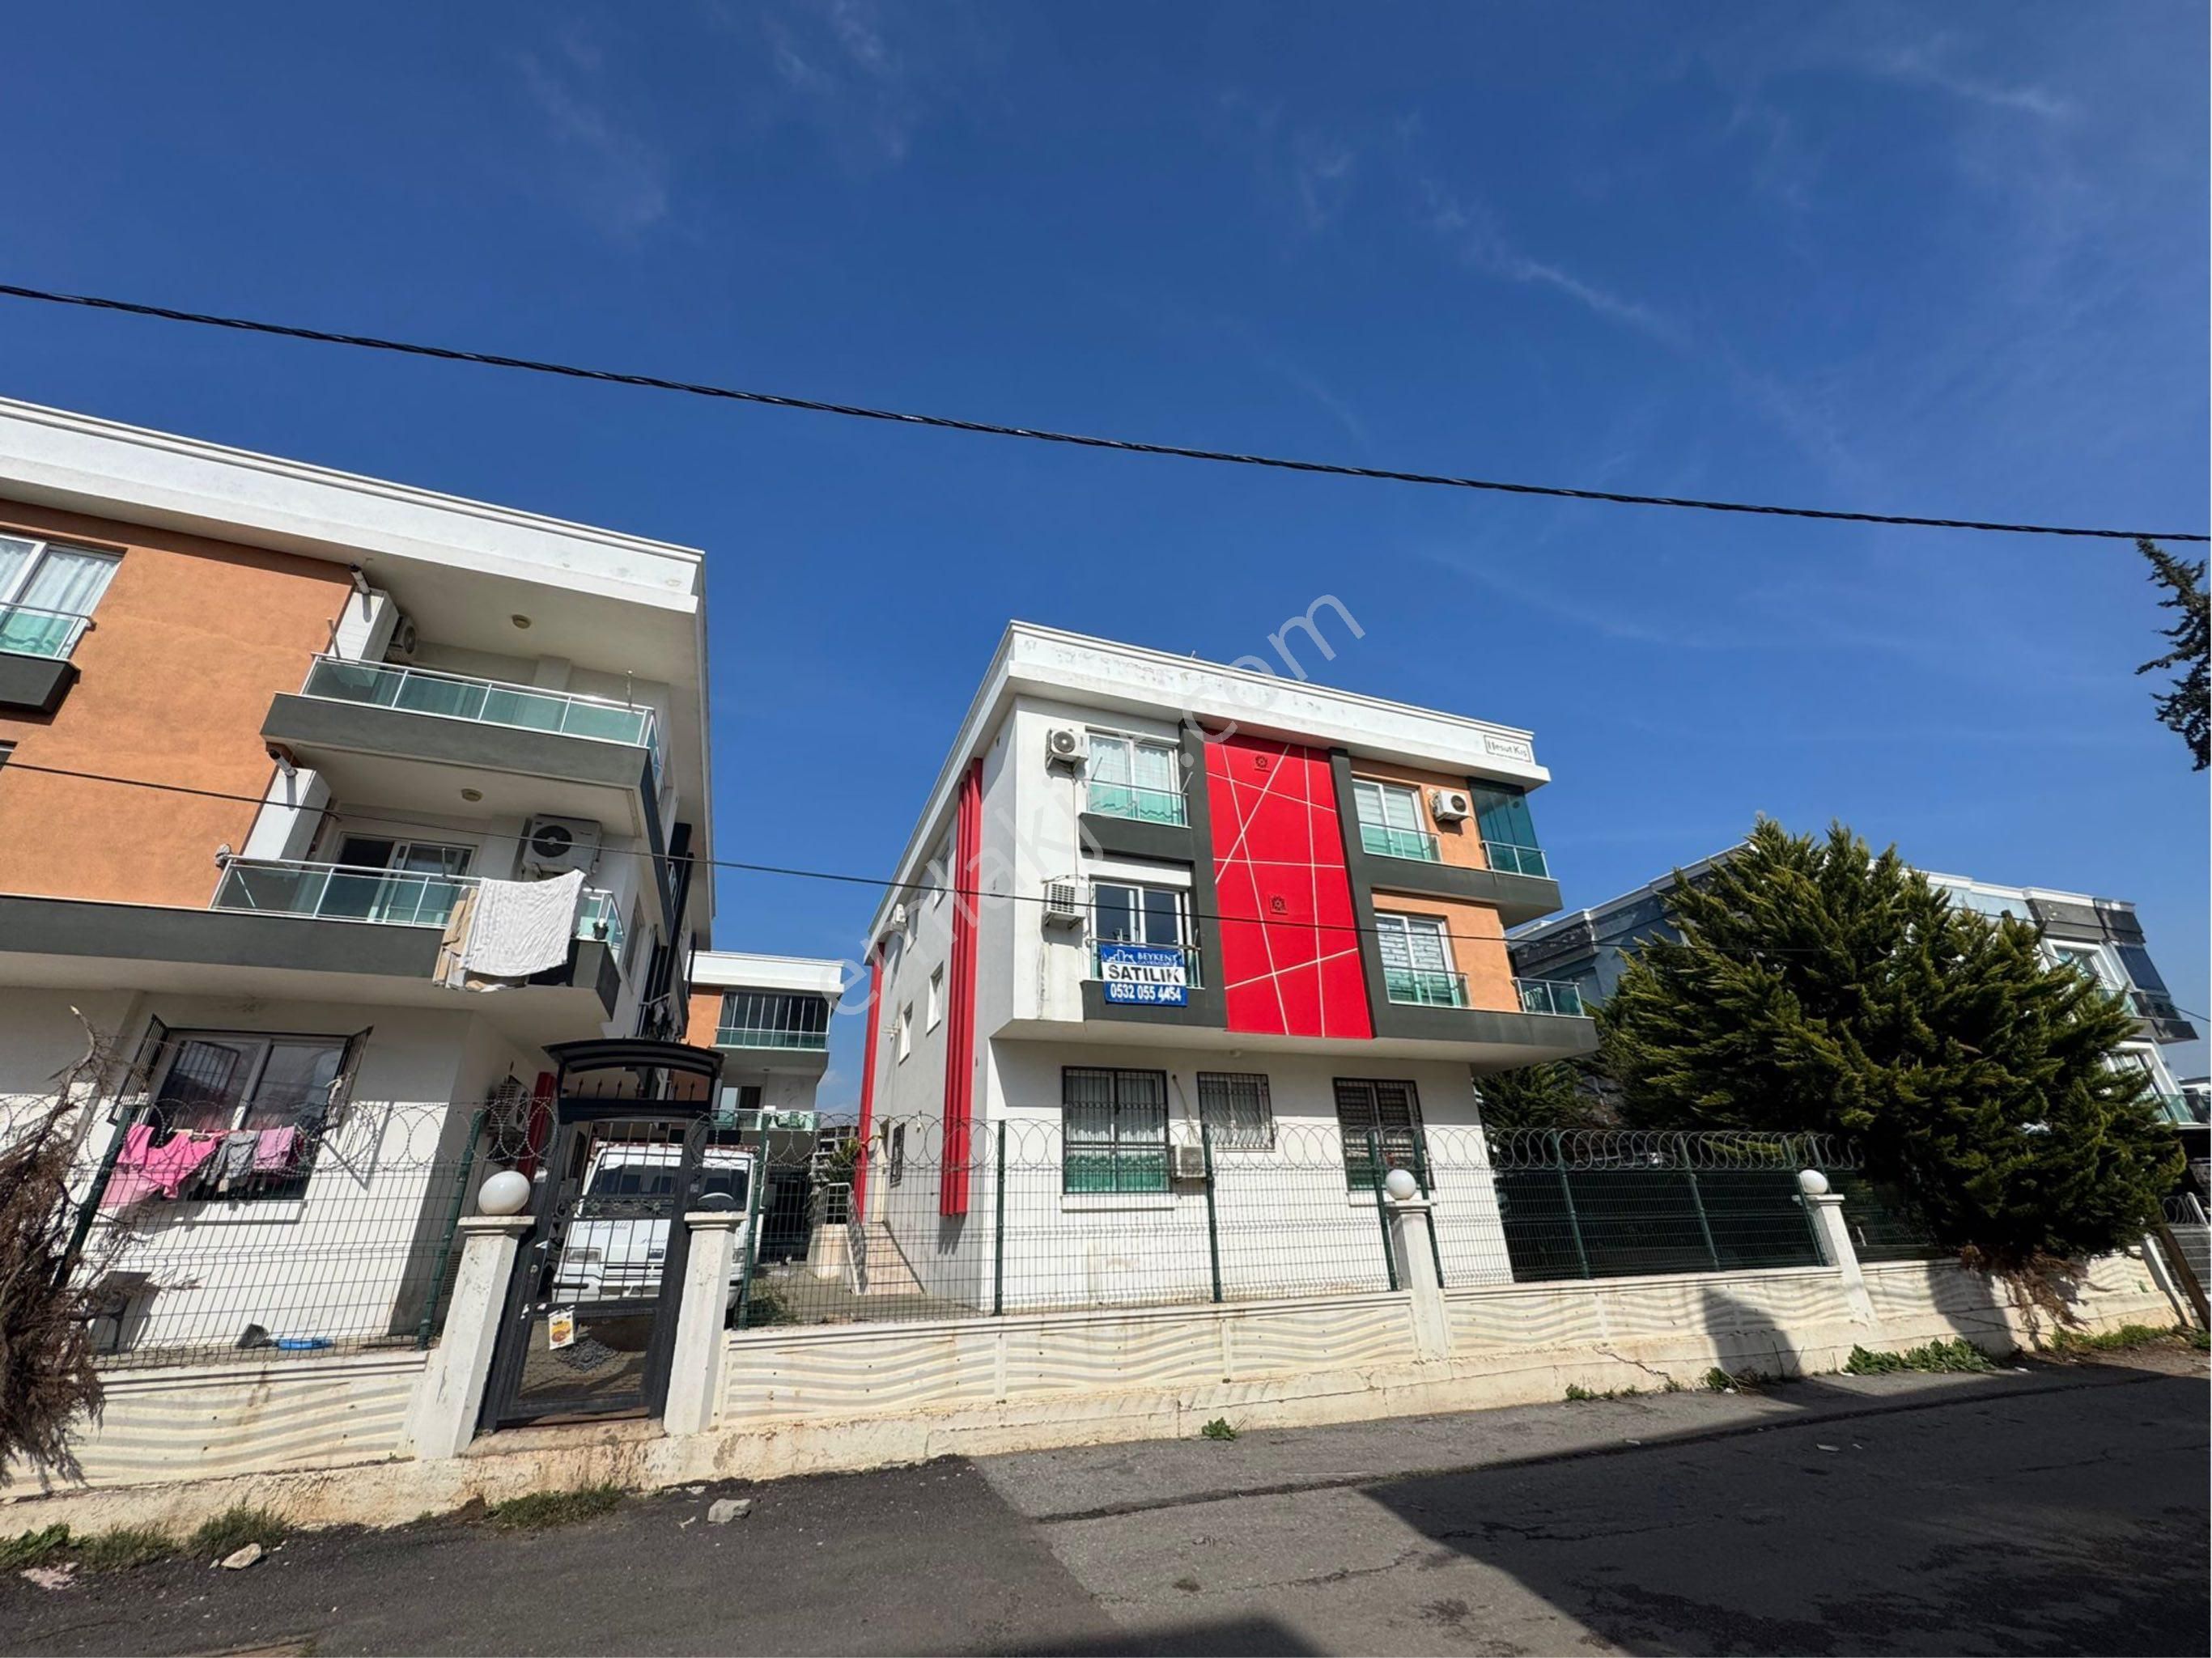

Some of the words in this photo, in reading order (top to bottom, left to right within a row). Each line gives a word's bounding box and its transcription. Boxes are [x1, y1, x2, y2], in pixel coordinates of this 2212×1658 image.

[1137, 952, 1178, 962] BEYKENT
[1109, 965, 1180, 983] SATILIK
[1110, 983, 1136, 999] 0532
[1137, 985, 1156, 1000] 055
